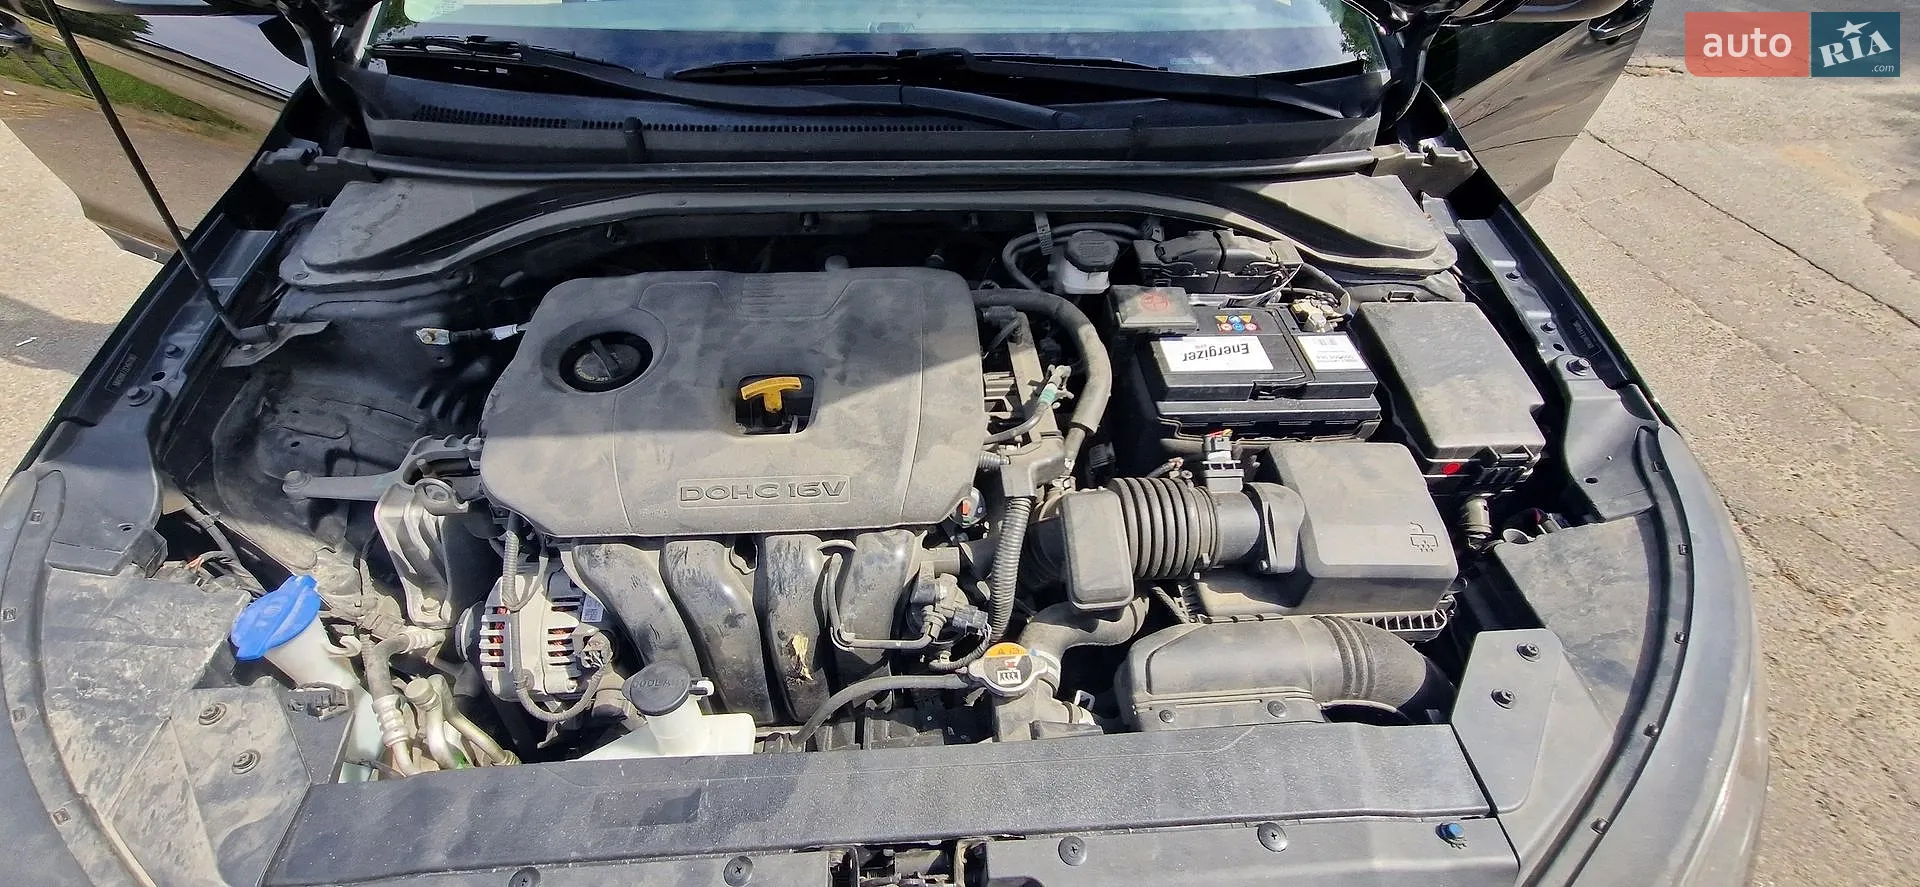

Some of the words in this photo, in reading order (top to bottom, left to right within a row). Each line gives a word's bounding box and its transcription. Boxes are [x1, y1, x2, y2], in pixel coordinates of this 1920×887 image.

[1182, 342, 1250, 363] Energizer
[680, 483, 779, 502] DOHC
[788, 480, 847, 498] 16V
